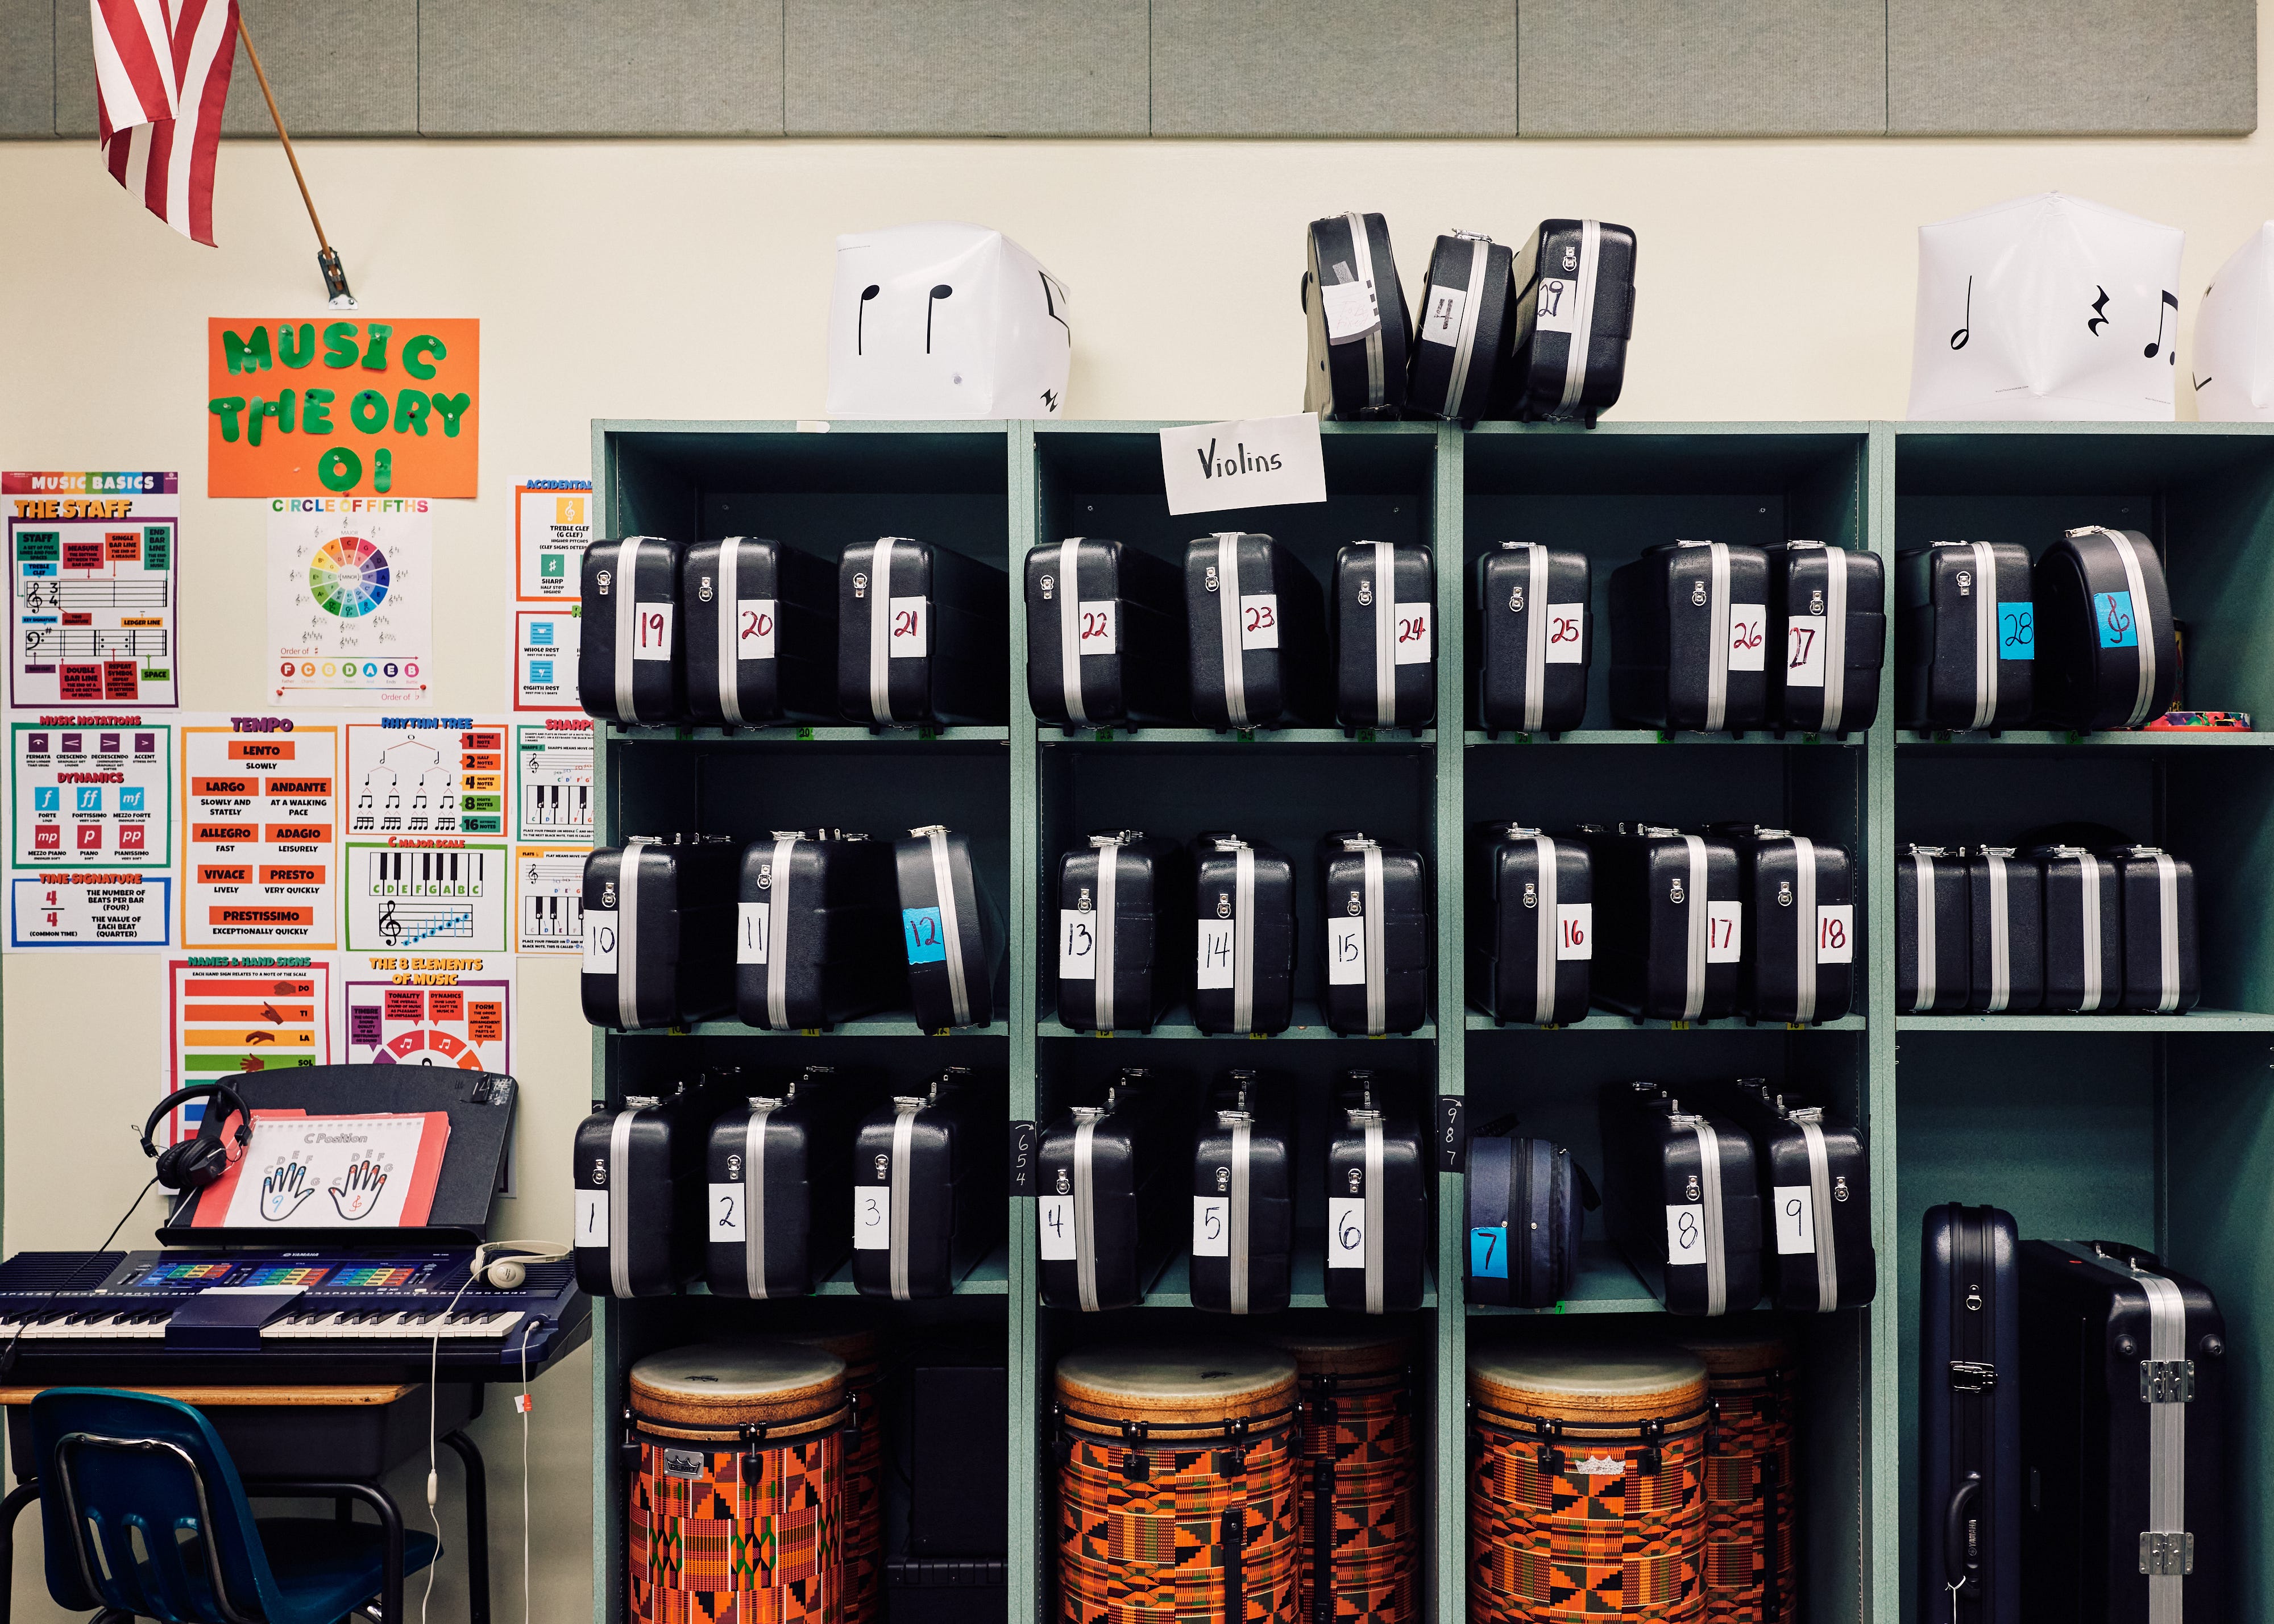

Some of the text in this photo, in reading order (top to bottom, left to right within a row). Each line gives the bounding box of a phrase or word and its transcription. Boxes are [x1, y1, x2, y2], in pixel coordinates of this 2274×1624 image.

[1537, 280, 1564, 318] 29
[223, 322, 447, 380] MUSIC
[209, 389, 471, 447] THEORY
[1197, 438, 1282, 479] Violins
[32, 476, 154, 489] MUSIC BASICS
[14, 500, 133, 519] THE STAFF
[272, 500, 428, 513] CIRCLE OF FIFTHS
[23, 534, 53, 542] STAFF
[741, 611, 772, 638] 20
[894, 610, 918, 637] 21
[1081, 612, 1108, 639] 22
[1245, 608, 1275, 632] 23
[641, 612, 663, 647] 19
[1399, 616, 1425, 643] 24
[1551, 617, 1579, 643] 25
[1733, 621, 1762, 650] 26
[2005, 612, 2034, 646] 28
[1789, 627, 1815, 669] 27
[39, 716, 142, 726] MUSIC NOTATIONS
[231, 717, 293, 732] TEMPO
[381, 717, 473, 729] RHYTHM TREE
[467, 735, 474, 747] 1
[799, 728, 810, 738] 20
[922, 729, 931, 738] 21
[243, 746, 280, 755] LENTO
[466, 755, 475, 768] 2
[57, 772, 125, 783] DYNAMICS
[466, 776, 475, 788] 4
[206, 782, 245, 791] LARGO
[271, 783, 326, 792] ANDANTE
[465, 798, 475, 809] 8
[464, 819, 479, 829] 16
[200, 828, 251, 838] ALLEGRO
[276, 829, 321, 838] ADAGIO
[388, 837, 396, 847] C
[399, 840, 434, 848] MAJOR
[39, 874, 142, 884] TIME SIGNATURE
[205, 870, 244, 879] VIVACE
[270, 870, 314, 879] PRESTO
[46, 891, 57, 905] 4
[47, 912, 57, 927] 4
[223, 911, 299, 921] PRESTISSIMO
[747, 916, 762, 951] 11
[912, 916, 941, 947] 12
[1069, 923, 1092, 956] 13
[1563, 920, 1584, 948] 16
[1711, 917, 1732, 948] 17
[1821, 917, 1846, 949] 18
[592, 925, 616, 955] 10
[1339, 933, 1358, 962] 15
[1207, 932, 1230, 969] 14
[188, 957, 311, 967] NAMES & HAND SIGNS
[370, 958, 483, 970] THE 8 ELEMENTS
[392, 973, 458, 985] OF MUSIC
[1448, 1108, 1457, 1123] 9
[304, 1133, 367, 1143] C Position
[1019, 1134, 1028, 1150] 6
[1446, 1127, 1454, 1143] 8
[1016, 1153, 1025, 1168] 5
[1447, 1151, 1455, 1165] 7
[1016, 1173, 1025, 1186] 4
[590, 1202, 595, 1233] 1
[719, 1197, 736, 1228] 2
[865, 1199, 881, 1226] 3
[1787, 1199, 1803, 1236] 9
[1048, 1204, 1064, 1238] 4
[1205, 1207, 1221, 1240] 5
[1338, 1210, 1362, 1250] 6
[1679, 1212, 1698, 1249] 8
[1478, 1233, 1497, 1270] 7
